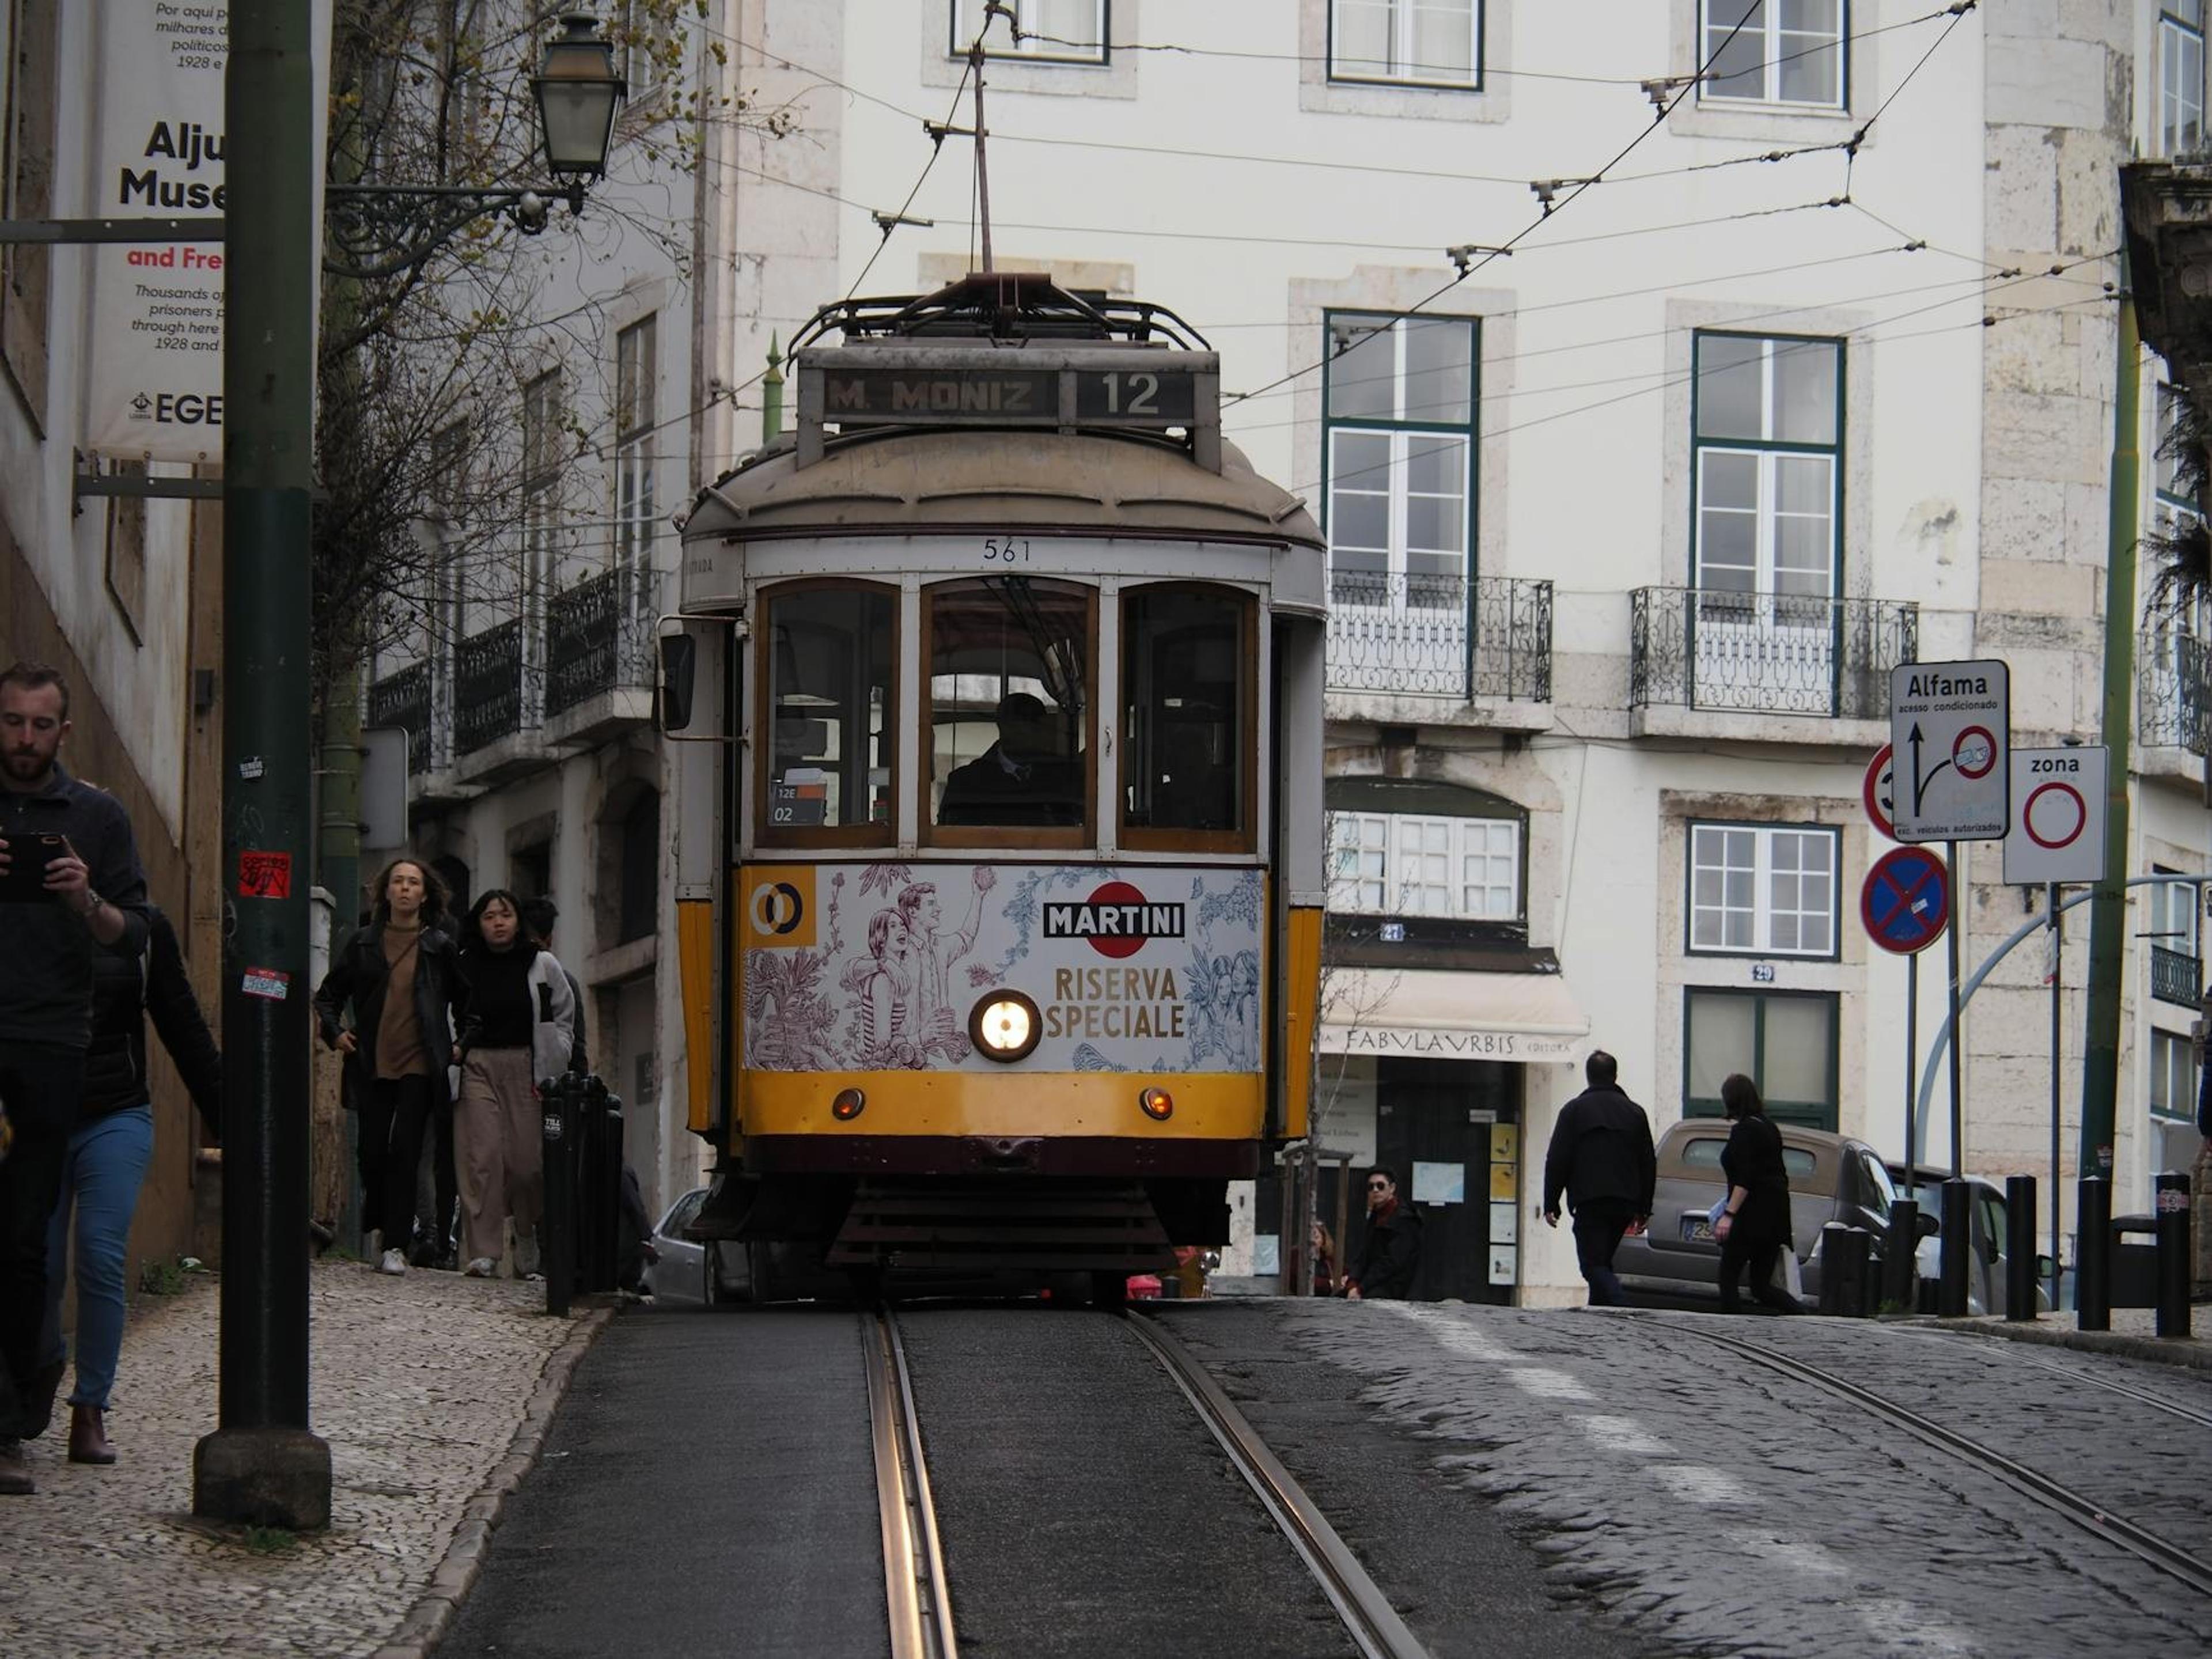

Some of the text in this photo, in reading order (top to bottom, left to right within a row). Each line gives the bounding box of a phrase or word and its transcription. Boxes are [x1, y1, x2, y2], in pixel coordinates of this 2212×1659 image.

[156, 2, 179, 15] Por
[183, 6, 214, 20] aqui
[156, 21, 214, 35] milhares
[176, 56, 222, 69] 1928 e
[128, 247, 224, 270] and Fre
[135, 284, 209, 300] Thousands
[149, 304, 212, 317] prisoners
[132, 319, 219, 335] through here
[154, 337, 219, 351] 1928 and
[893, 381, 1032, 411] MONIZ
[1102, 372, 1160, 414] 12
[156, 393, 224, 425] EGE
[984, 539, 1029, 562] 561
[1908, 674, 1988, 697] Alfama
[1899, 700, 1998, 713] acesso condicionado
[2032, 759, 2080, 772] zona
[778, 788, 797, 799] 12E
[774, 808, 793, 821] 02
[1953, 822, 2001, 833] autorizados
[1048, 906, 1180, 935] MARTINI
[1056, 968, 1177, 1001] RISERVA
[1046, 1005, 1184, 1039] SPECIALE
